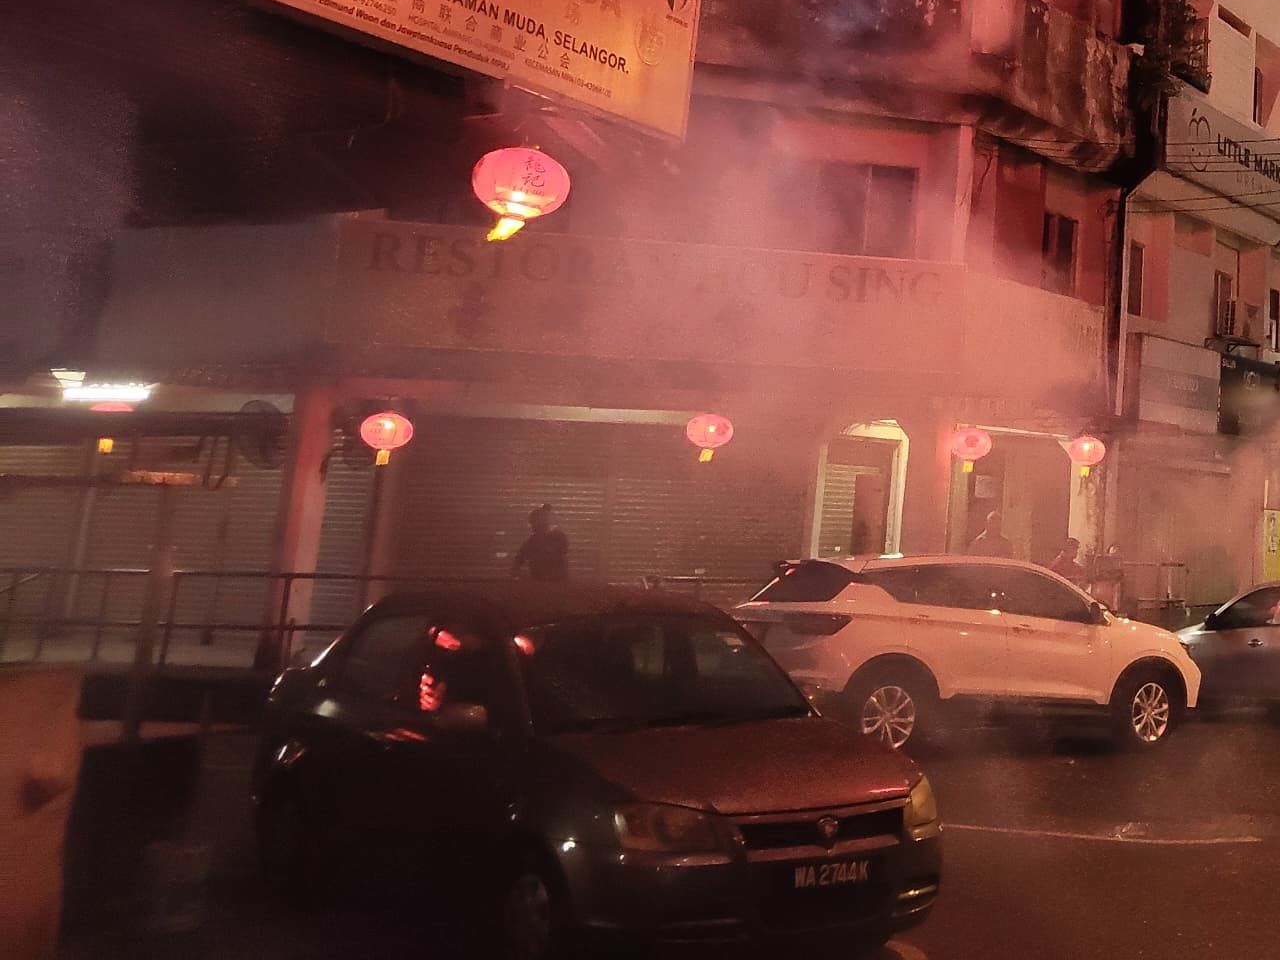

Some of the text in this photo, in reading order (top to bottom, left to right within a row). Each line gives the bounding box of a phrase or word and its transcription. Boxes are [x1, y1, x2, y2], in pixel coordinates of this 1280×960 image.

[504, 9, 549, 42] MUDA,
[553, 30, 630, 75] SELANGOR.
[1217, 132, 1250, 169] LITTLE
[825, 262, 944, 307] SING
